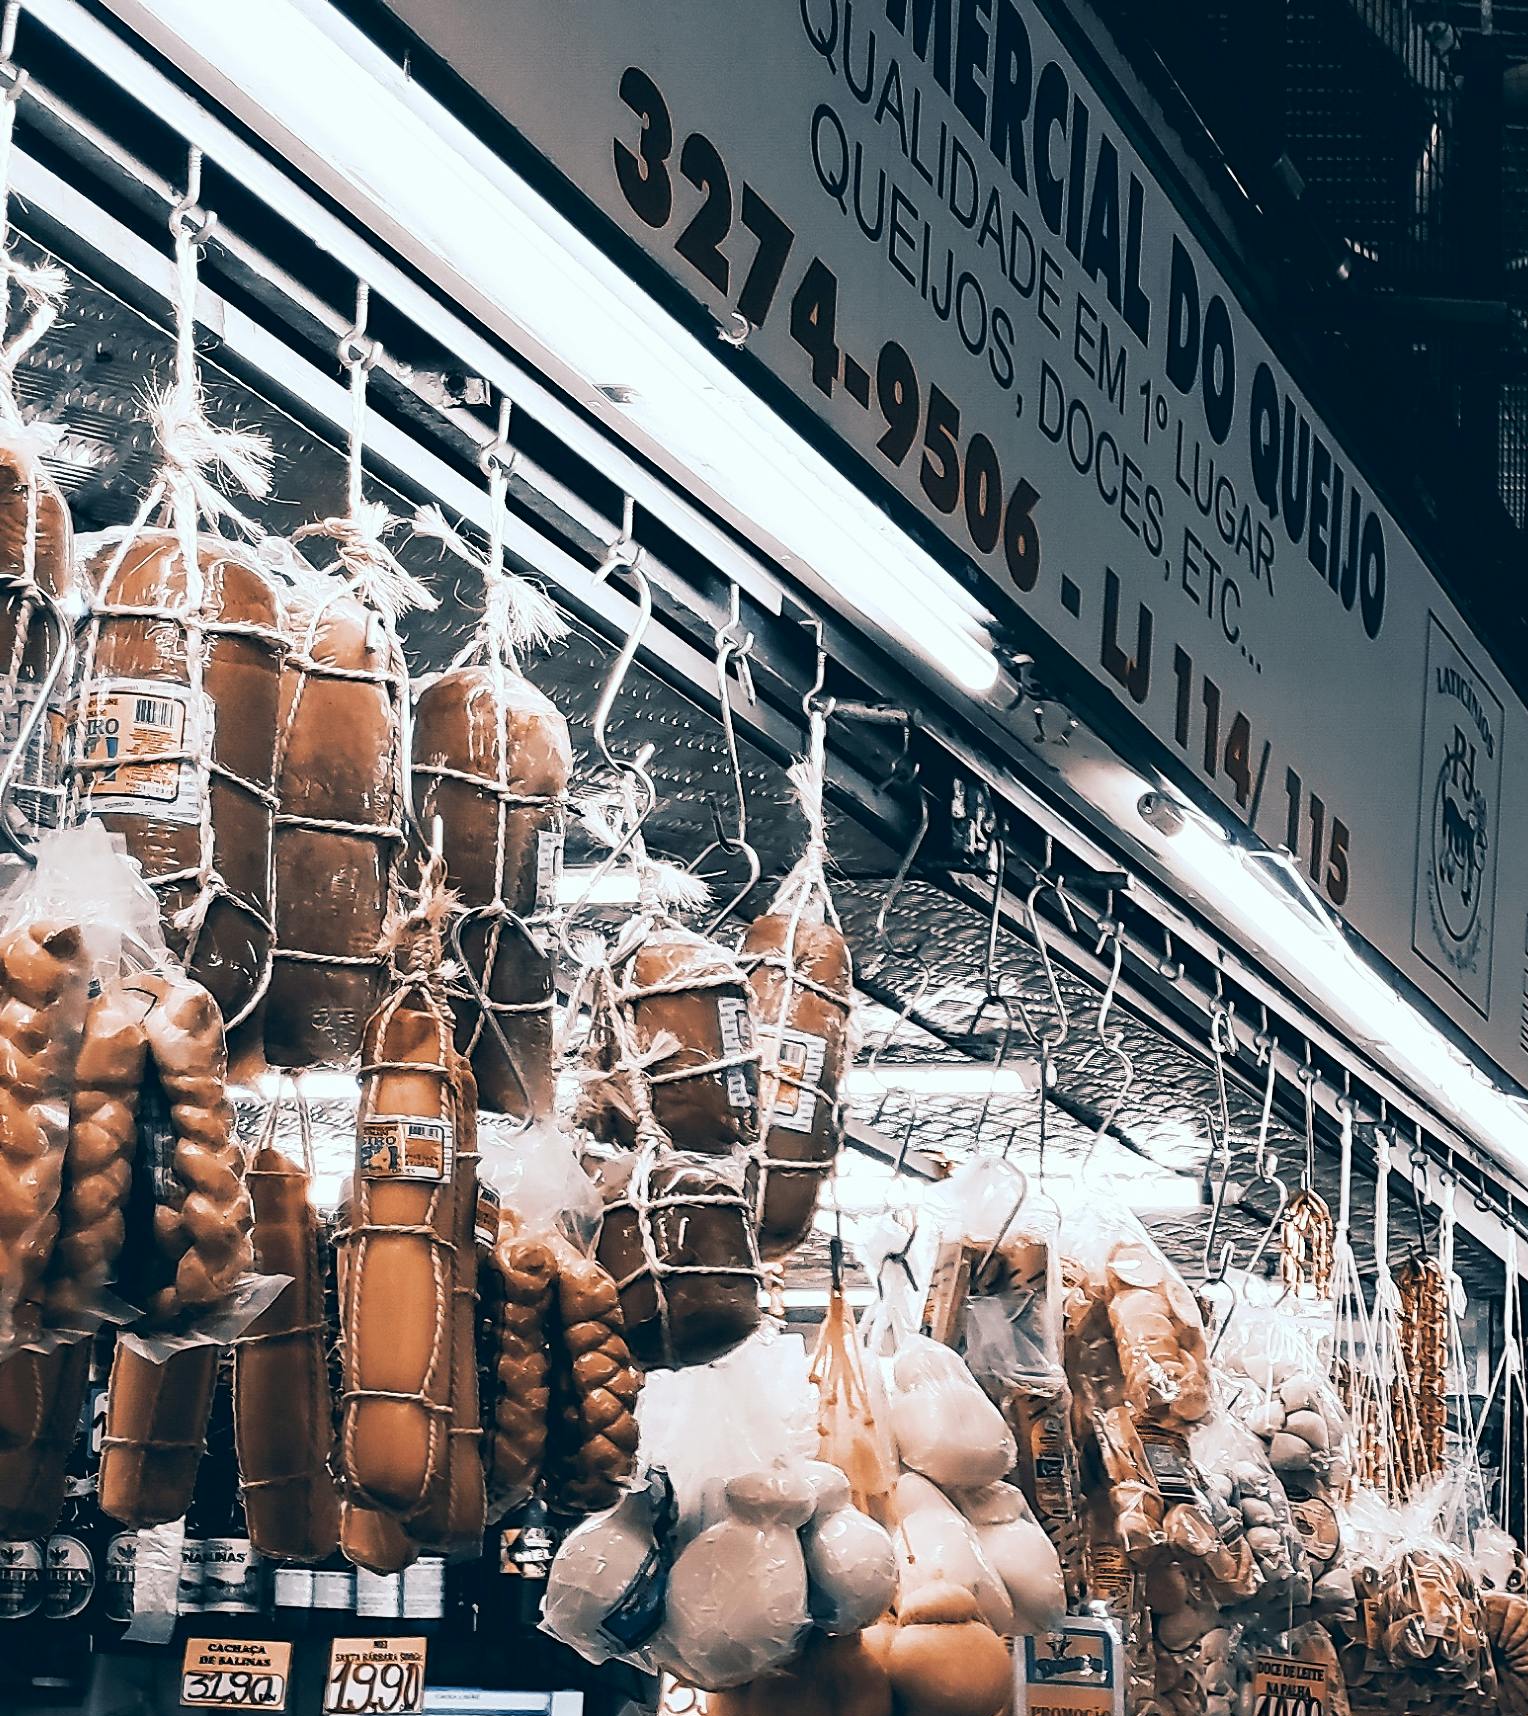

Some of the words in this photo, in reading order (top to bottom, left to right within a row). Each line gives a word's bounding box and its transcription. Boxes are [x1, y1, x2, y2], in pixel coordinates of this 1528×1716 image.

[615, 66, 1041, 591] 3274-9506
[1100, 567, 1153, 702] LJ
[800, 0, 1062, 330] QUALIDADE
[1075, 279, 1127, 414] EM
[1175, 428, 1275, 595] LUGAR
[811, 103, 1022, 418] QUEIJOS,
[1041, 371, 1170, 582] DOCES,
[1166, 234, 1236, 445] DO
[1248, 363, 1388, 639] QUEIJO
[199, 1656, 215, 1665] DE
[218, 1656, 271, 1667] SALINAS
[208, 1643, 266, 1656] CACHAÇA
[1258, 1662, 1282, 1676] DOCE
[1284, 1665, 1296, 1677] DE
[1297, 1666, 1324, 1681] LEITE
